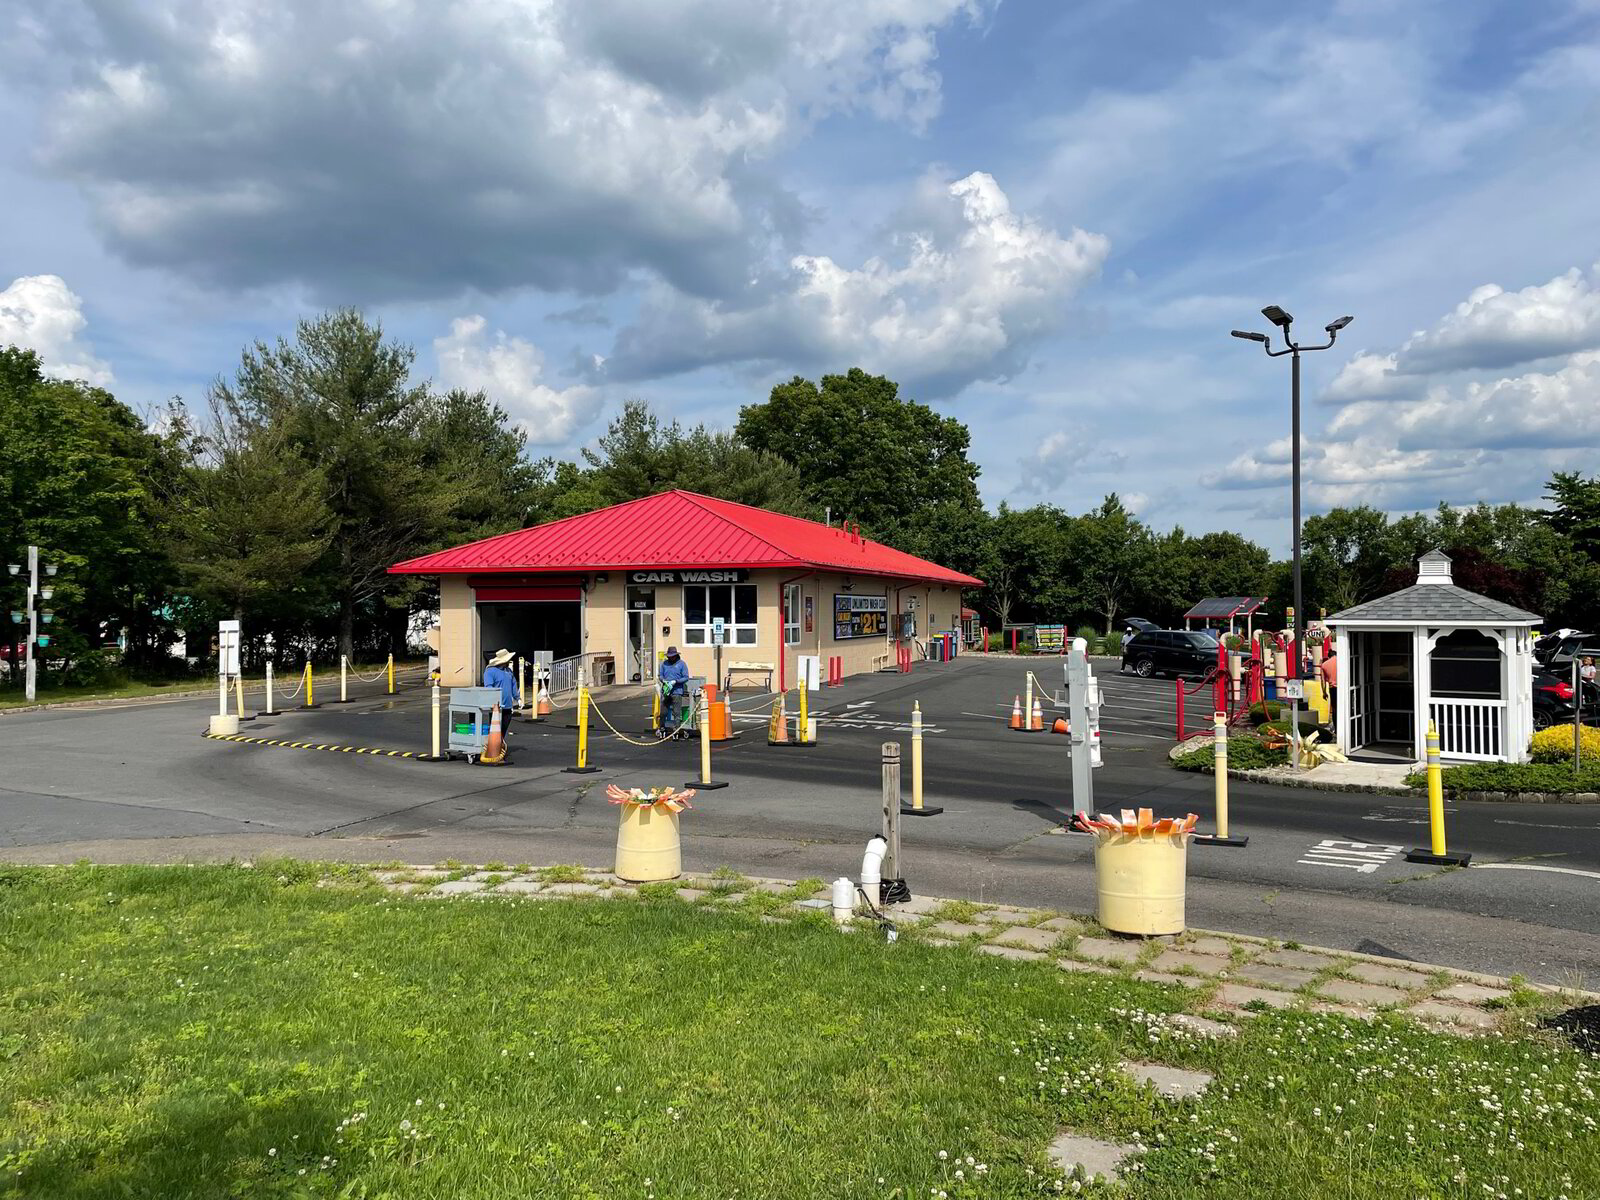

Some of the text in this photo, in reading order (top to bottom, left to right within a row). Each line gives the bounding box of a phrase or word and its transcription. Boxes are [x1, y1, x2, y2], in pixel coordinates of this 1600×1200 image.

[633, 571, 738, 582] CAR WASH
[1296, 840, 1404, 873] EXIT
